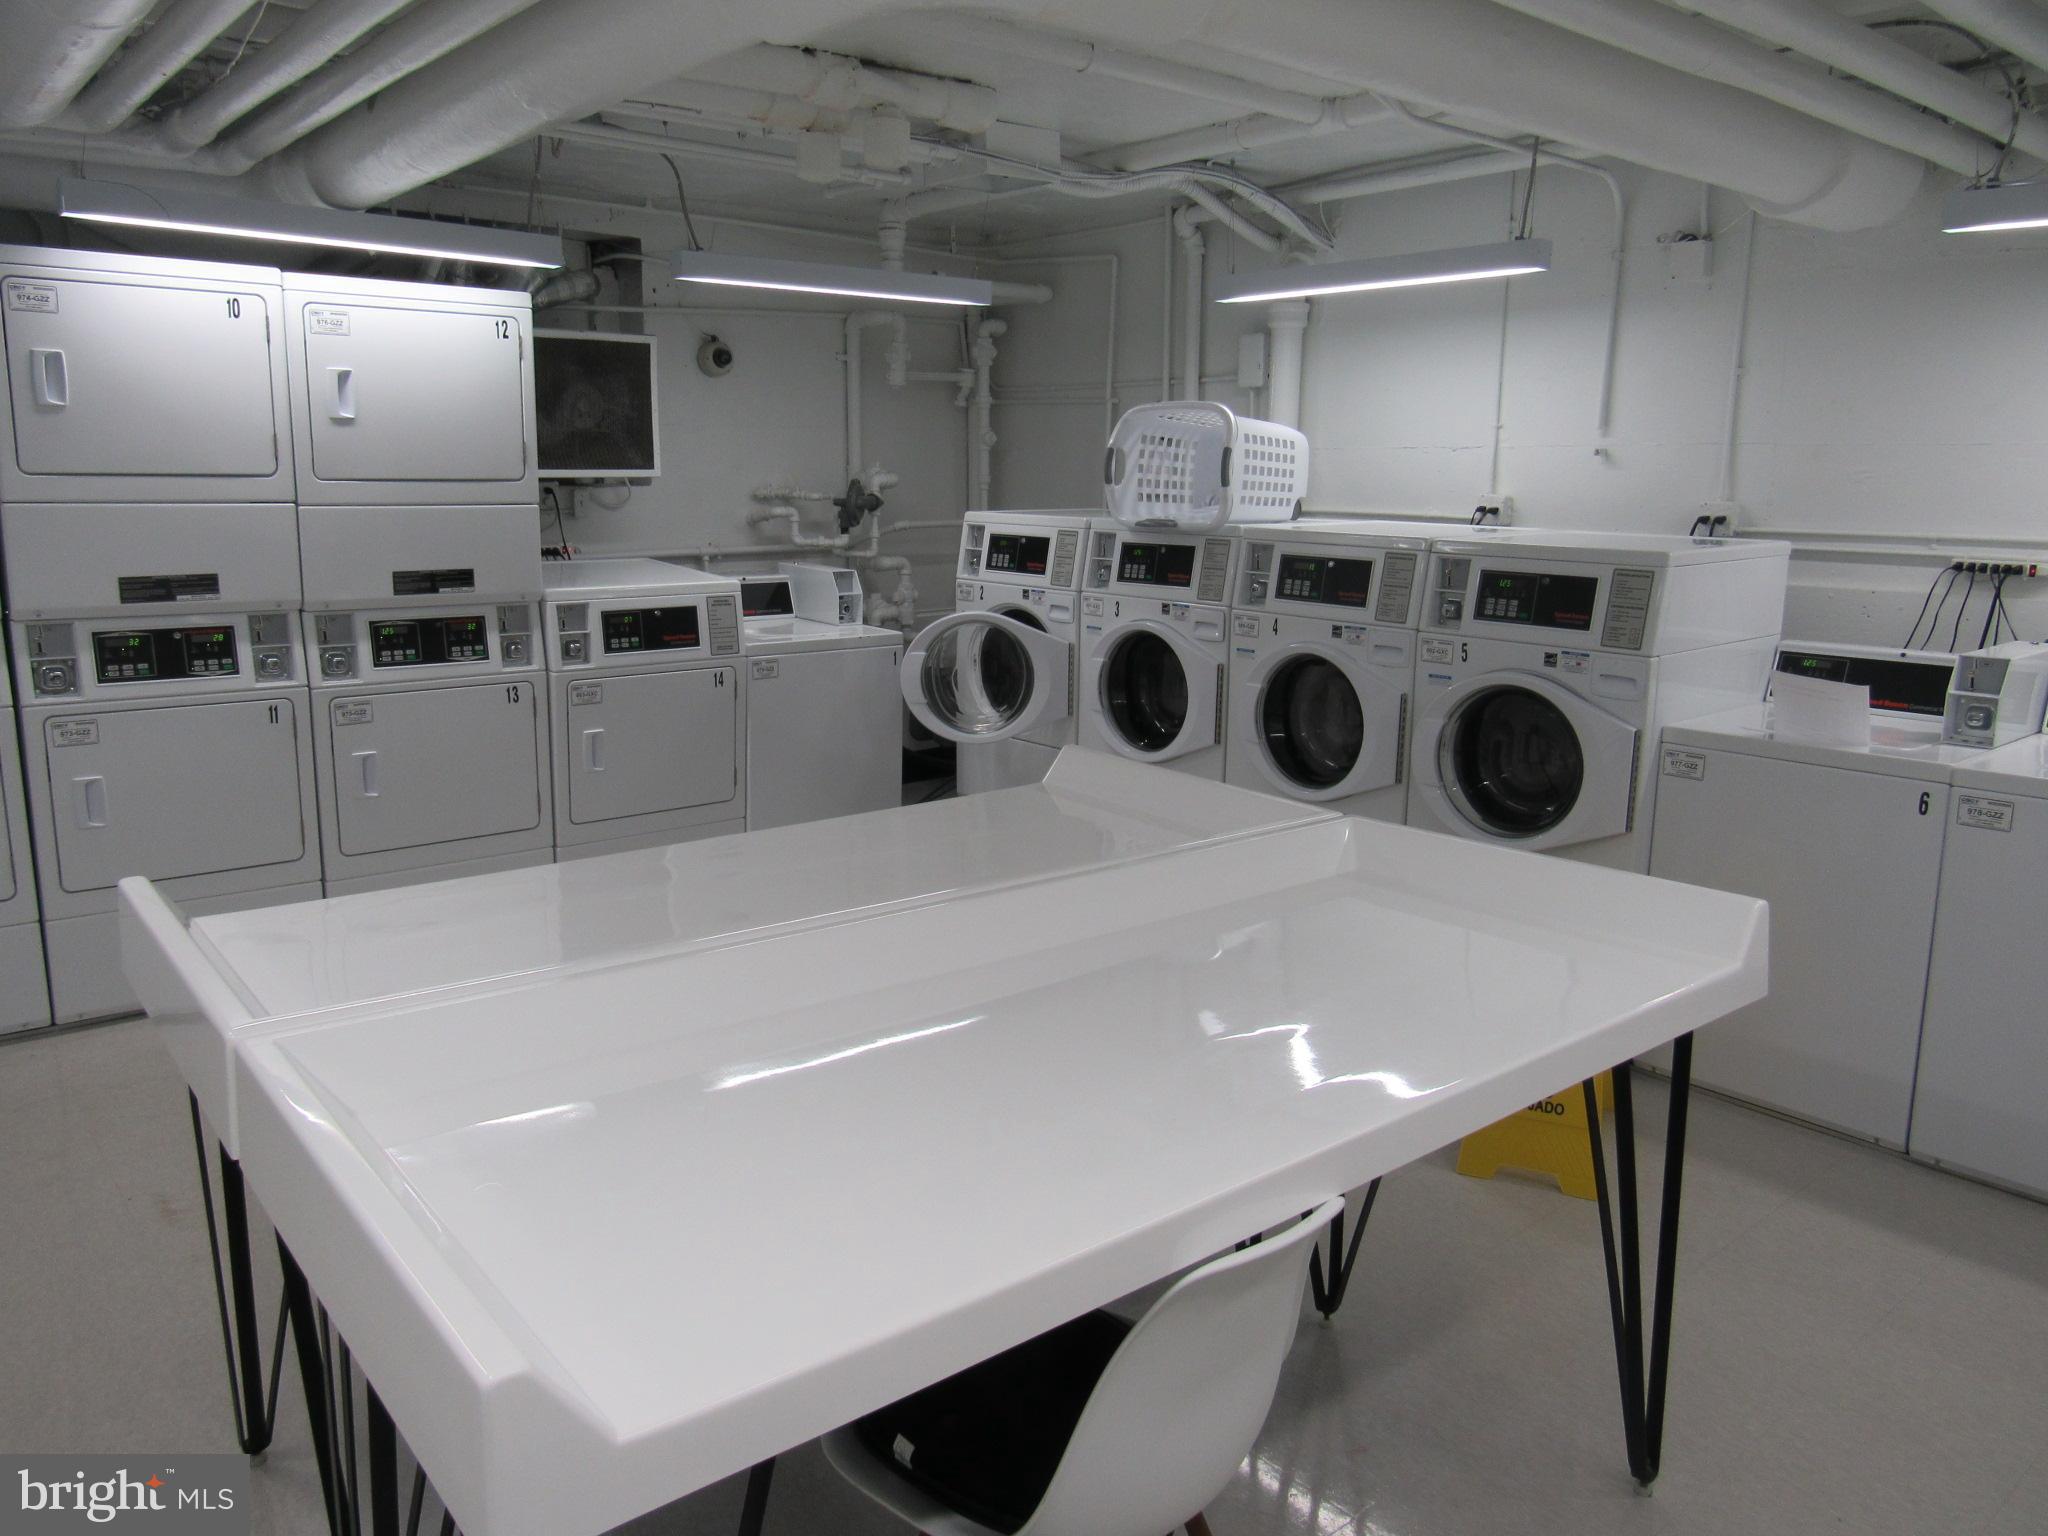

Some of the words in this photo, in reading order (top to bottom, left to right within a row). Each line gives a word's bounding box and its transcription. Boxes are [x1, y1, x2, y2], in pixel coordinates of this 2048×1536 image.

[226, 298, 240, 319] 10
[495, 320, 509, 339] 12
[979, 585, 985, 600] 2
[1114, 601, 1120, 618] 3
[1272, 618, 1279, 636] 4
[893, 650, 898, 666] 1
[1461, 642, 1468, 663] 5
[714, 671, 724, 688] 14
[506, 686, 519, 704] 13
[268, 705, 279, 724] 11
[1918, 791, 1930, 816] 6
